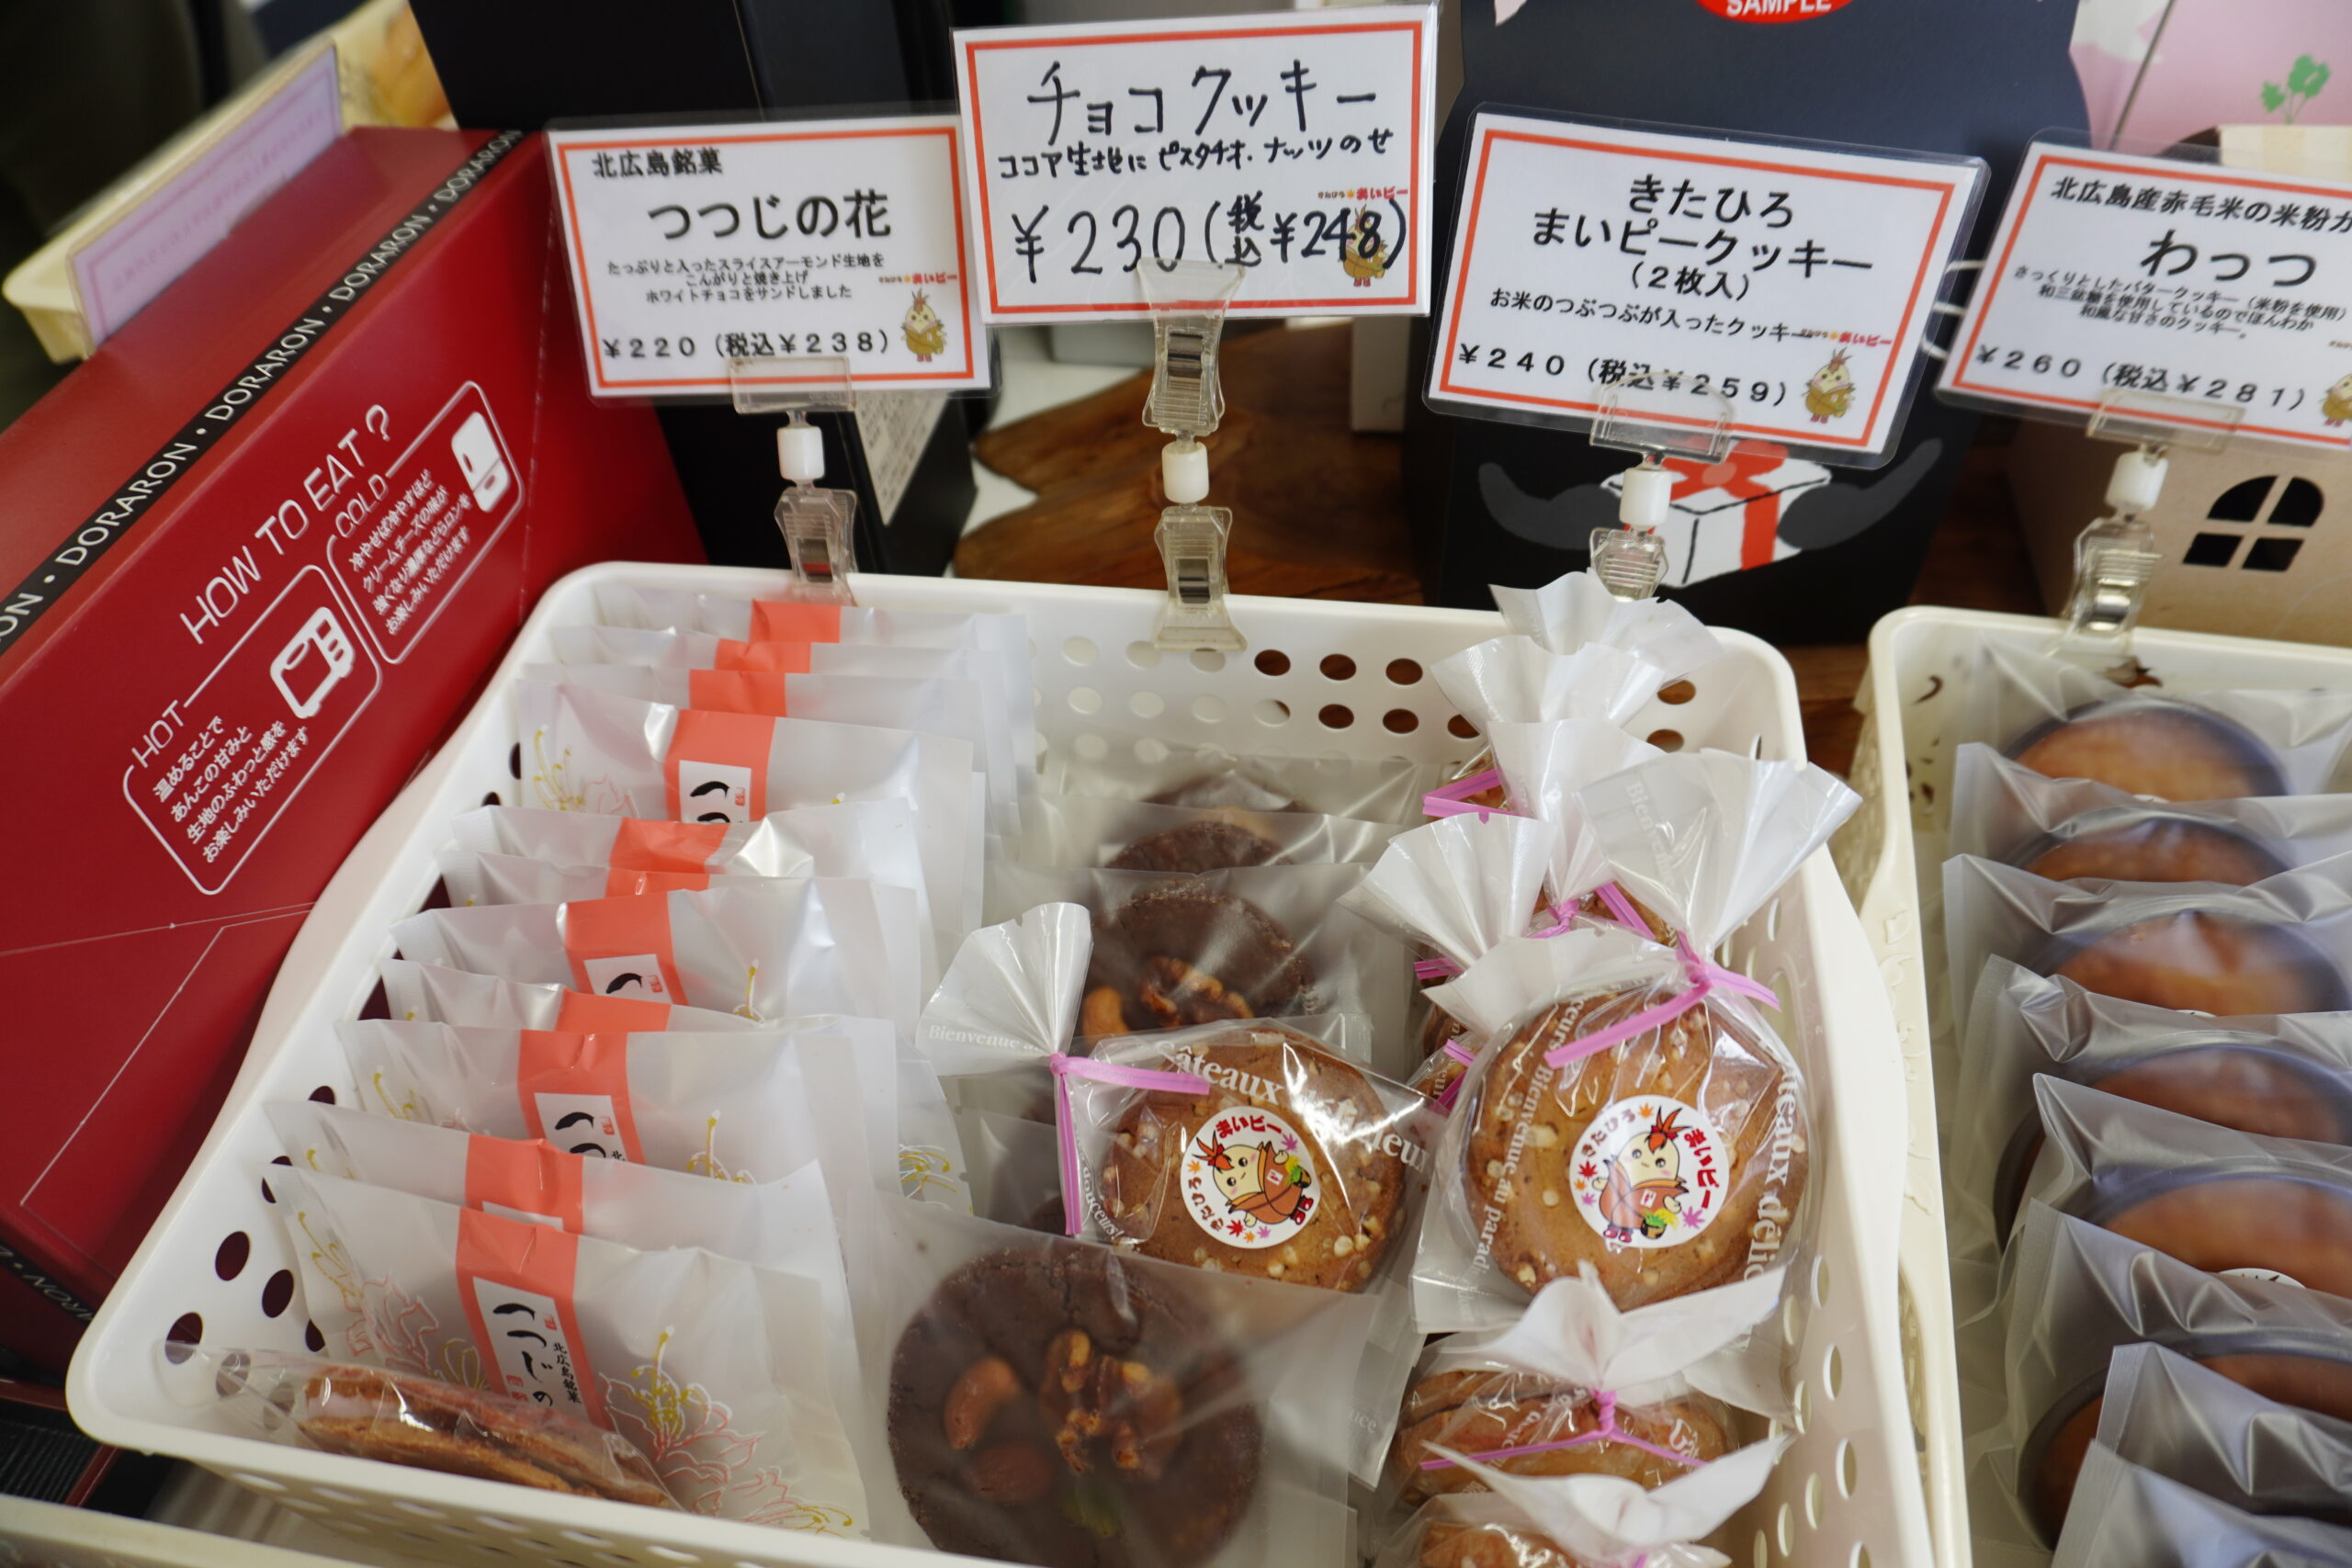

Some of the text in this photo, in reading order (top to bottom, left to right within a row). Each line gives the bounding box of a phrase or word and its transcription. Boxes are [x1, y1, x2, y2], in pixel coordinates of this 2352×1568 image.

[1726, 0, 1832, 17] SAMPLE
[1026, 60, 1376, 145] チョコクッキー
[434, 129, 523, 203] DORARON
[593, 147, 723, 178] 北広島銘菓
[1629, 175, 1795, 229] きたひろ
[647, 189, 891, 240] つつじの花
[1532, 208, 1873, 277] まいピークッキー
[329, 215, 432, 301] DORARON
[646, 285, 853, 303] ホワイトチョコをサンドしました
[686, 270, 808, 287] こんがりと焼き上げ
[1631, 262, 1749, 301] (2枚入)
[1489, 288, 1813, 343] お米のつぶつぶが入ったクッキー
[204, 318, 326, 423] DORARON
[55, 443, 198, 567] DORARON
[180, 546, 262, 644] HOW
[254, 500, 309, 555] TO
[303, 429, 365, 512] EAT
[335, 474, 389, 537] COLD
[348, 469, 434, 571] 冷やせば冷やすほど
[363, 485, 449, 592] クリームチーズの味が
[386, 525, 470, 635] お楽しみいただけます
[131, 700, 184, 768] HOT
[153, 716, 224, 803] 温めることで
[170, 726, 253, 822] あんこの甘みと
[187, 720, 288, 844] 生地のふわっと感を
[202, 726, 310, 863] お楽しみいただけます
[1505, 1062, 1555, 1175] Bienvenue
[1188, 1177, 1224, 1232] きたひろ
